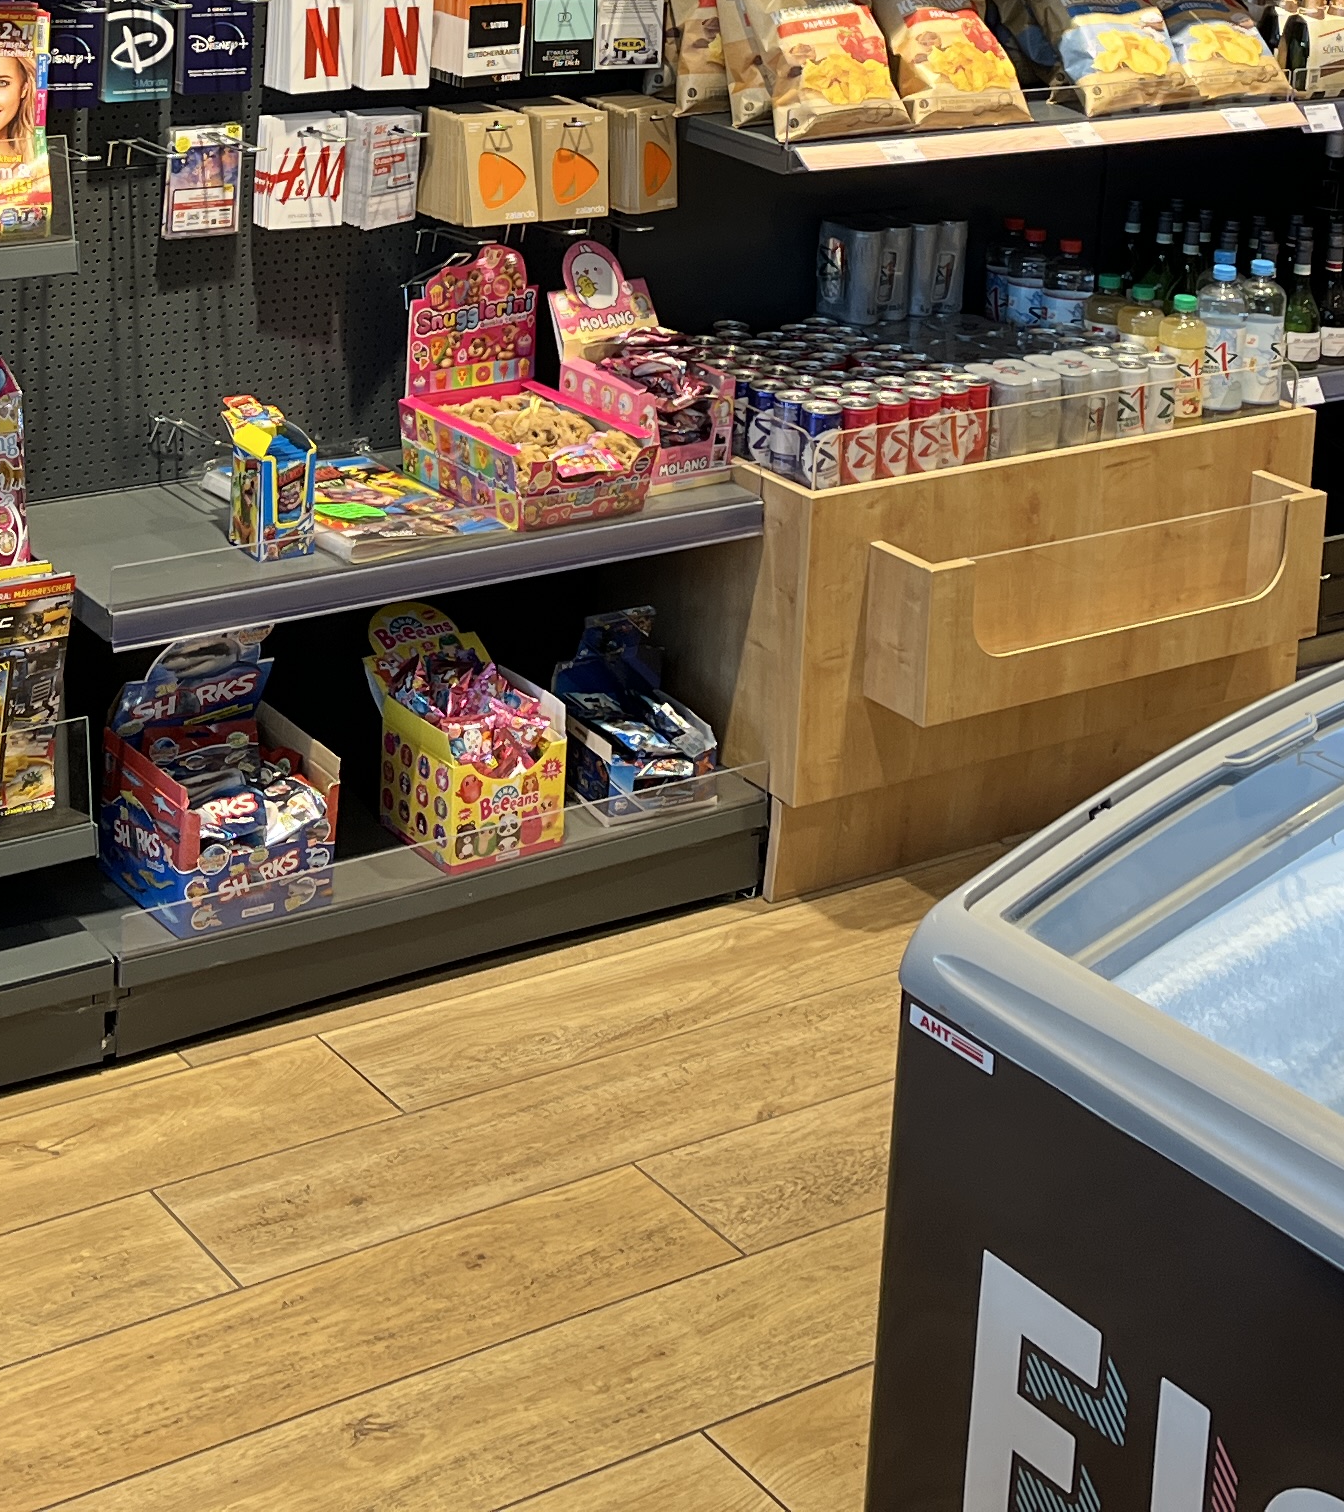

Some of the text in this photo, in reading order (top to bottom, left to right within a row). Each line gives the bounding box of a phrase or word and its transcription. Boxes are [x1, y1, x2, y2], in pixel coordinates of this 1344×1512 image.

[803, 18, 837, 29] PAPRIKA
[188, 35, 249, 55] Disney+
[269, 146, 345, 206] H&M
[505, 210, 536, 220] zalando
[417, 291, 535, 335] Snugglerini
[578, 311, 634, 332] MOLANG
[920, 1015, 951, 1042] AHT
